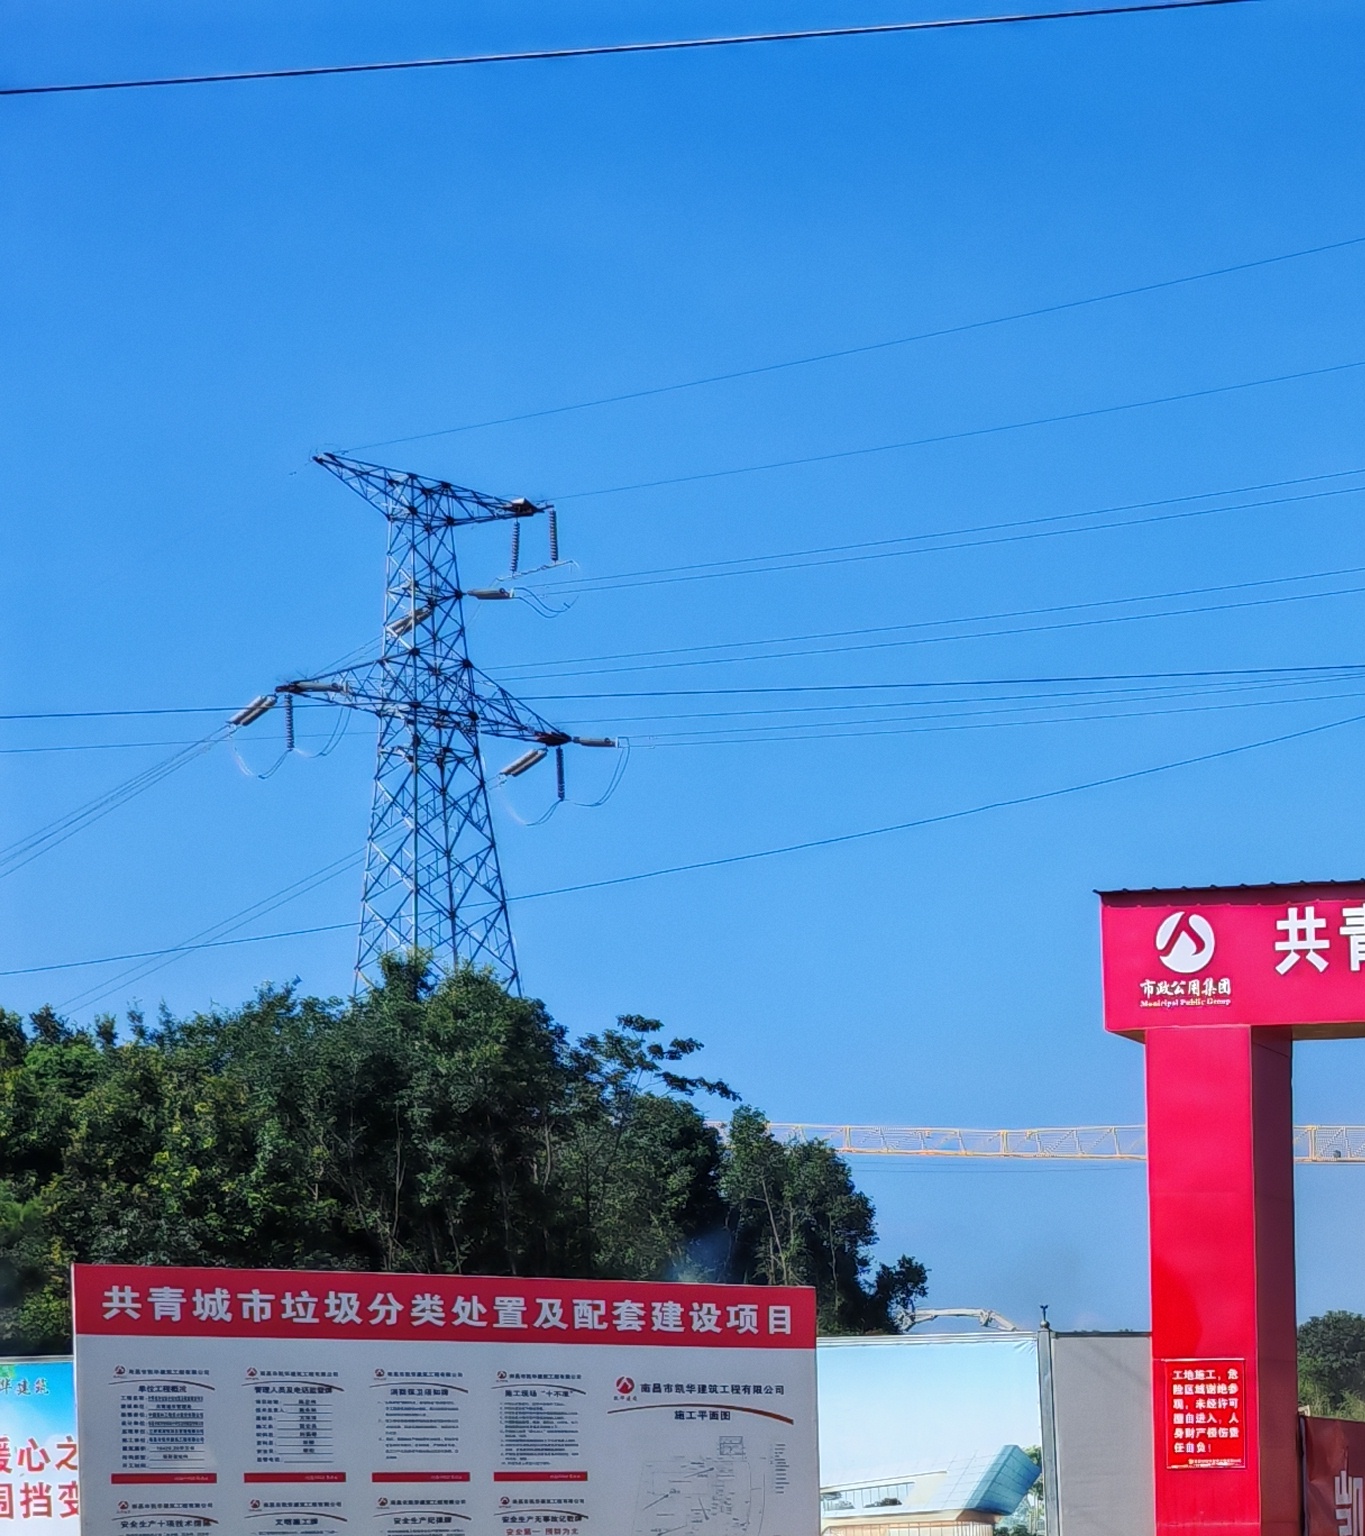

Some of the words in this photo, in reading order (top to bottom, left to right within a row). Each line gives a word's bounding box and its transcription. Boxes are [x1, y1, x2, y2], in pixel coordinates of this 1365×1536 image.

[1140, 977, 1232, 999] 市政公用集团
[102, 1285, 792, 1335] 共青城市垃圾分类处置及配套建设项目
[640, 1383, 785, 1396] 南昌市凯华建筑工程有限公司
[674, 1410, 731, 1421] 施工平面图
